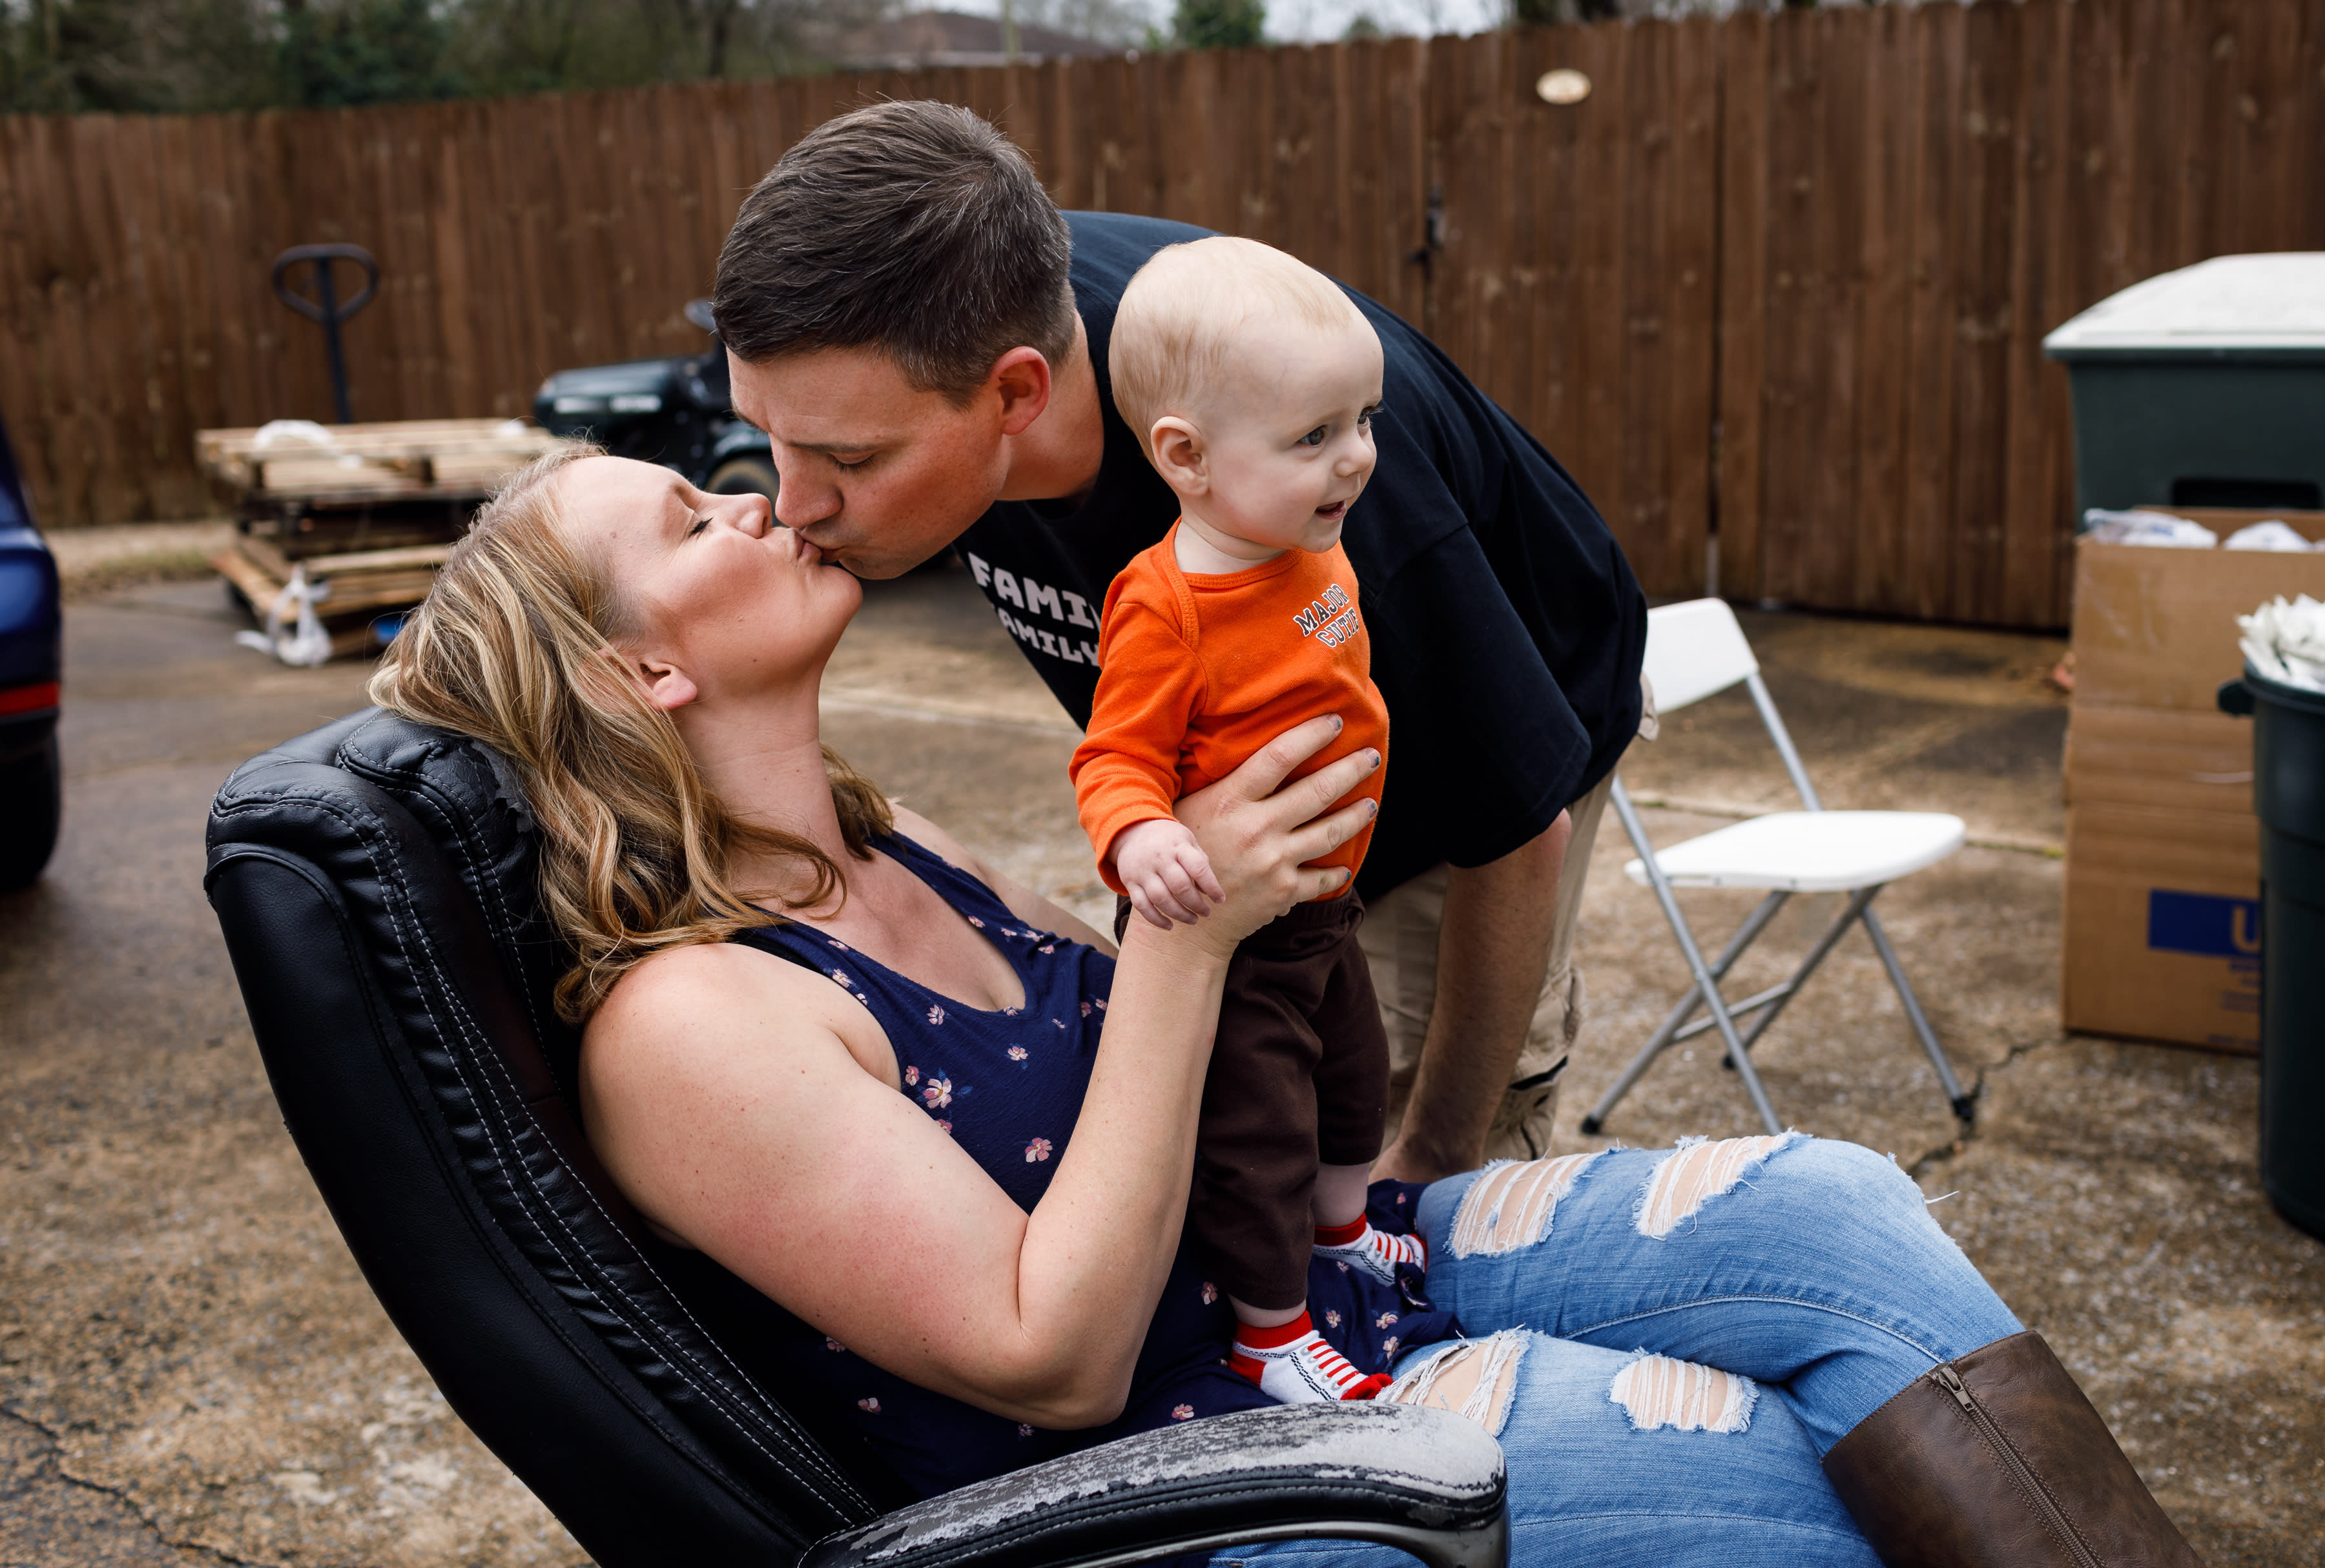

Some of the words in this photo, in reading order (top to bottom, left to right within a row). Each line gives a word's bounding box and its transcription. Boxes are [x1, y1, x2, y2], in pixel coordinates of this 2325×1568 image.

[969, 552, 1101, 634] FAMI
[1293, 584, 1349, 637] MAJOR
[1316, 607, 1359, 647] CUTIE
